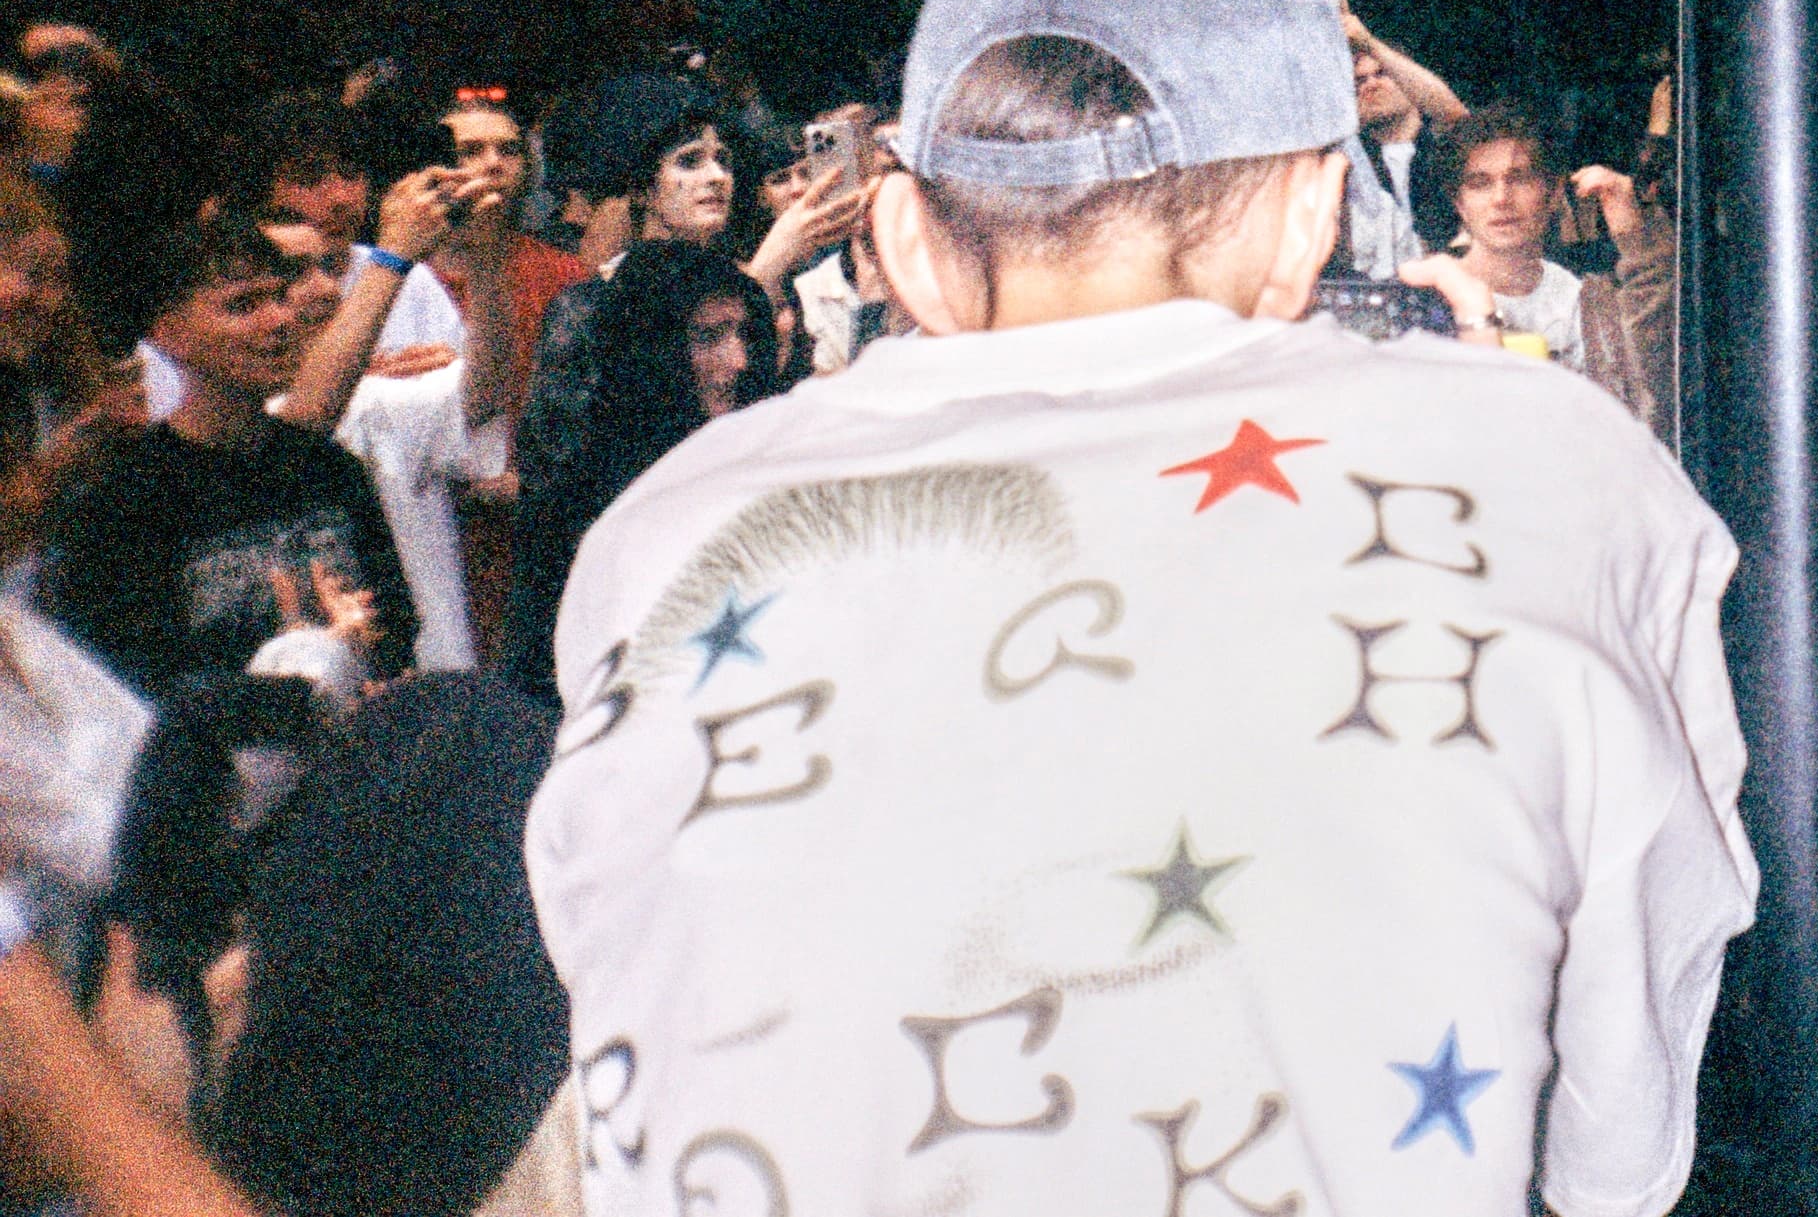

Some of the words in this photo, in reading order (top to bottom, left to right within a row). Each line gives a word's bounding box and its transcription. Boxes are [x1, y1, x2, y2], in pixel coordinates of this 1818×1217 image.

[1345, 471, 1491, 580] C
[1315, 613, 1505, 751] H
[676, 678, 836, 832] E
[899, 986, 1075, 1155] C
[1130, 1090, 1302, 1217] K
